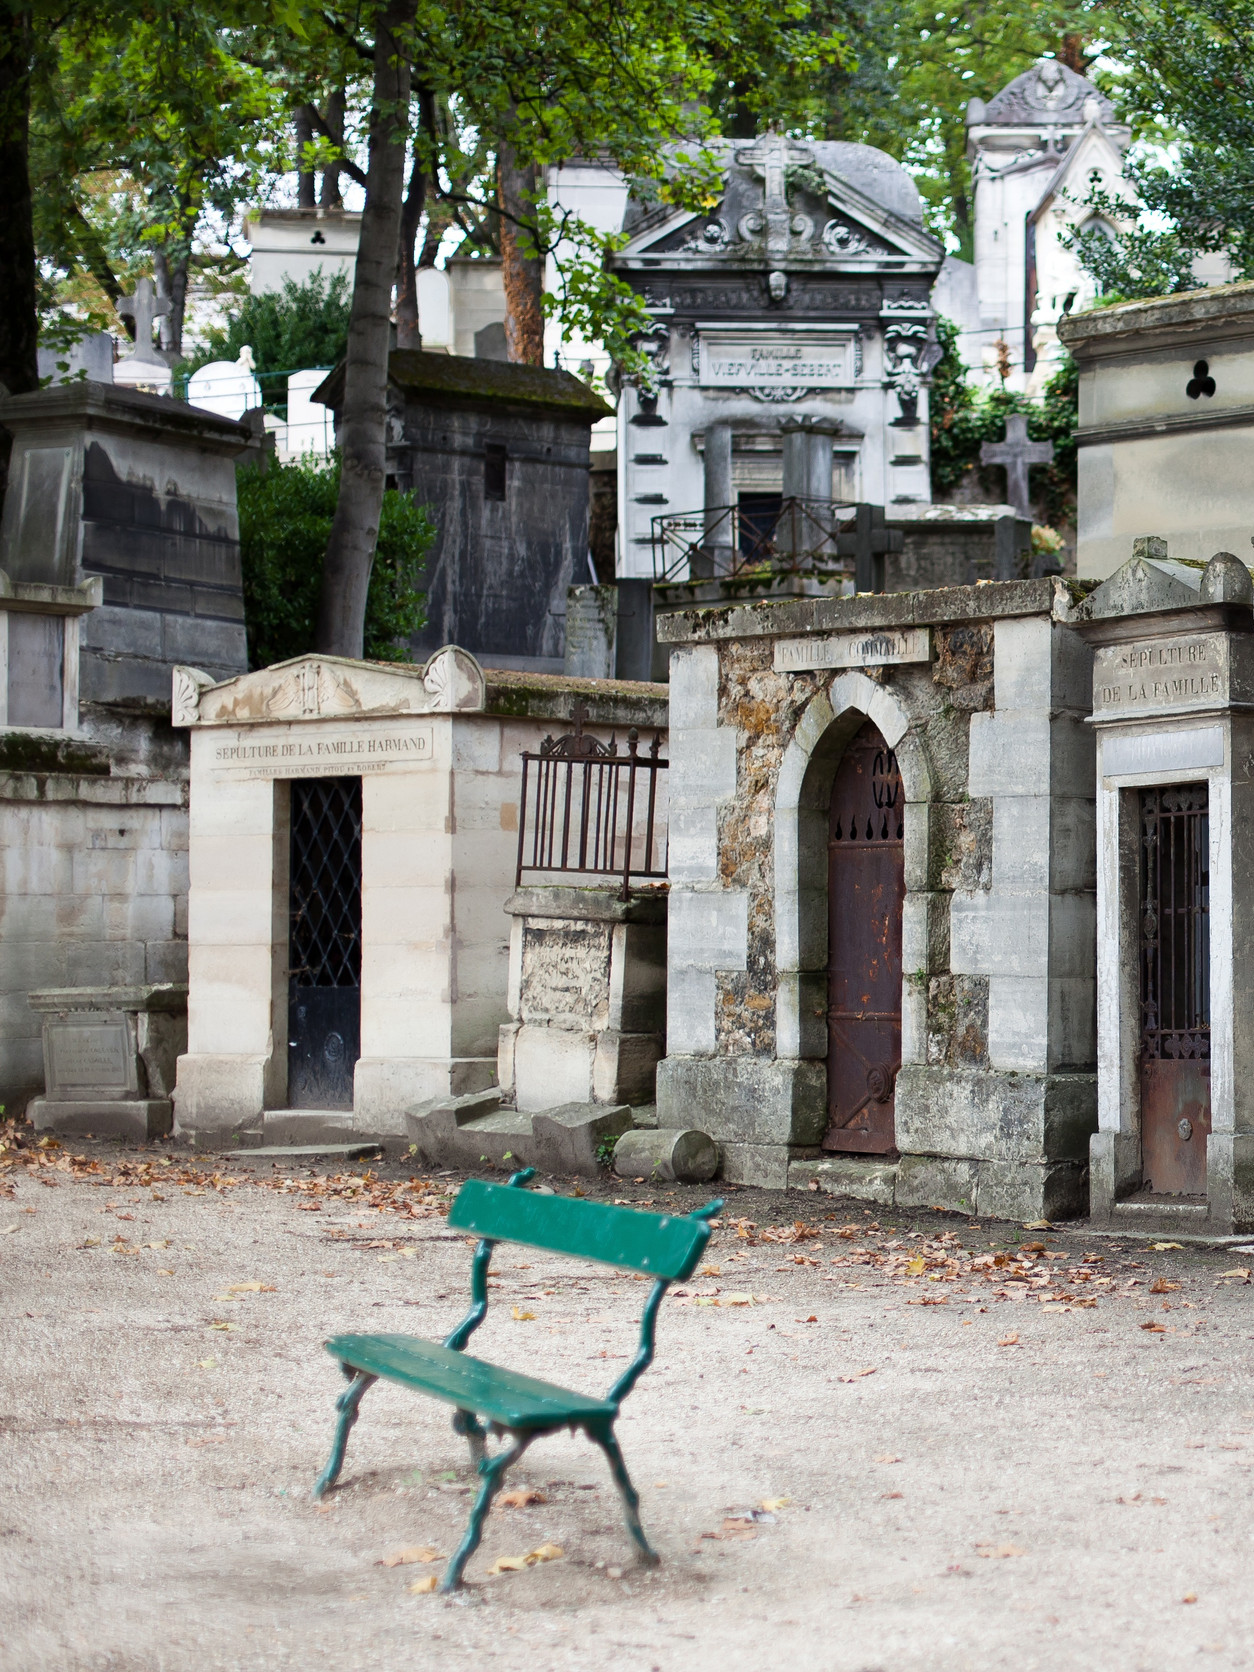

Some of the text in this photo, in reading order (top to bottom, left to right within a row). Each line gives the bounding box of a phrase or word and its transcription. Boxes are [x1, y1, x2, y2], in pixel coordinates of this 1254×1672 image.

[781, 641, 829, 664] FAMILLE
[1103, 674, 1219, 703] DE LA FAMILLE
[215, 737, 426, 760] SEPULTURE DE LA FAMILLE HARMAND
[356, 763, 387, 773] ROBERT
